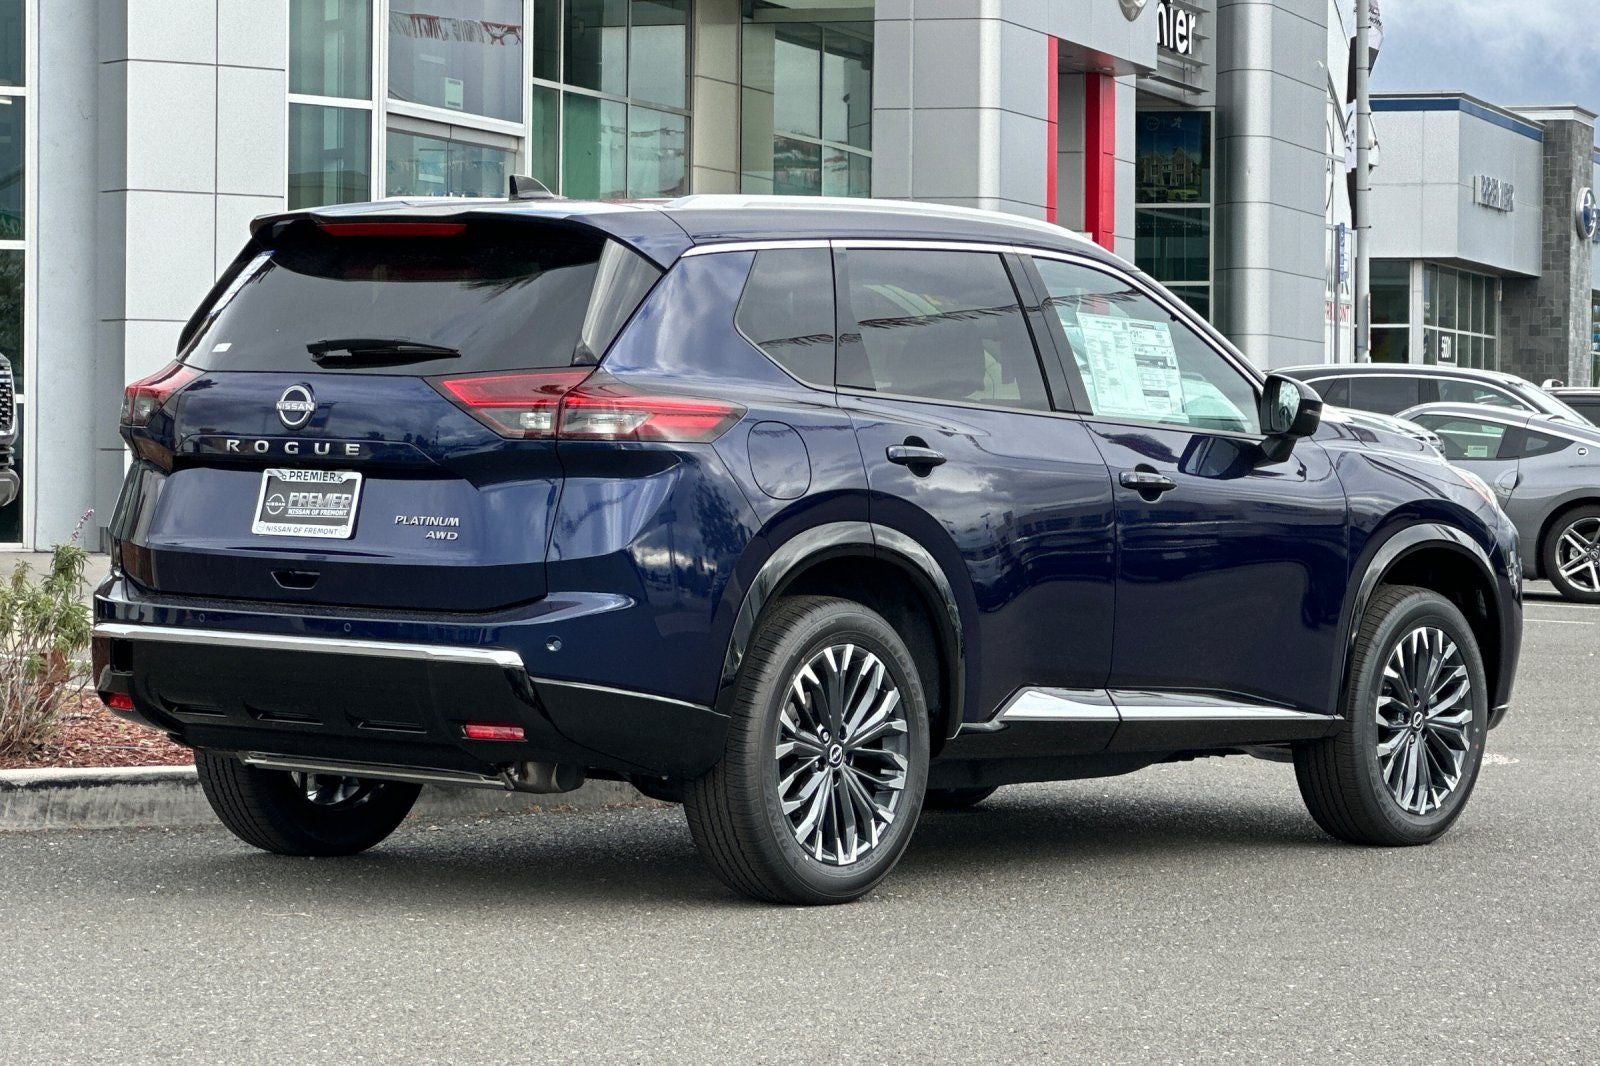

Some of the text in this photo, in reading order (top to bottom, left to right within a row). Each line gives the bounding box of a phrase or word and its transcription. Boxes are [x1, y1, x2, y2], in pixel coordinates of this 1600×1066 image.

[276, 401, 314, 411] NISSAN
[226, 440, 360, 455] ROGUE
[289, 471, 336, 481] PREMIER
[289, 492, 352, 508] PREMIER
[395, 515, 459, 526] PLATINUM
[426, 531, 459, 540] AWD
